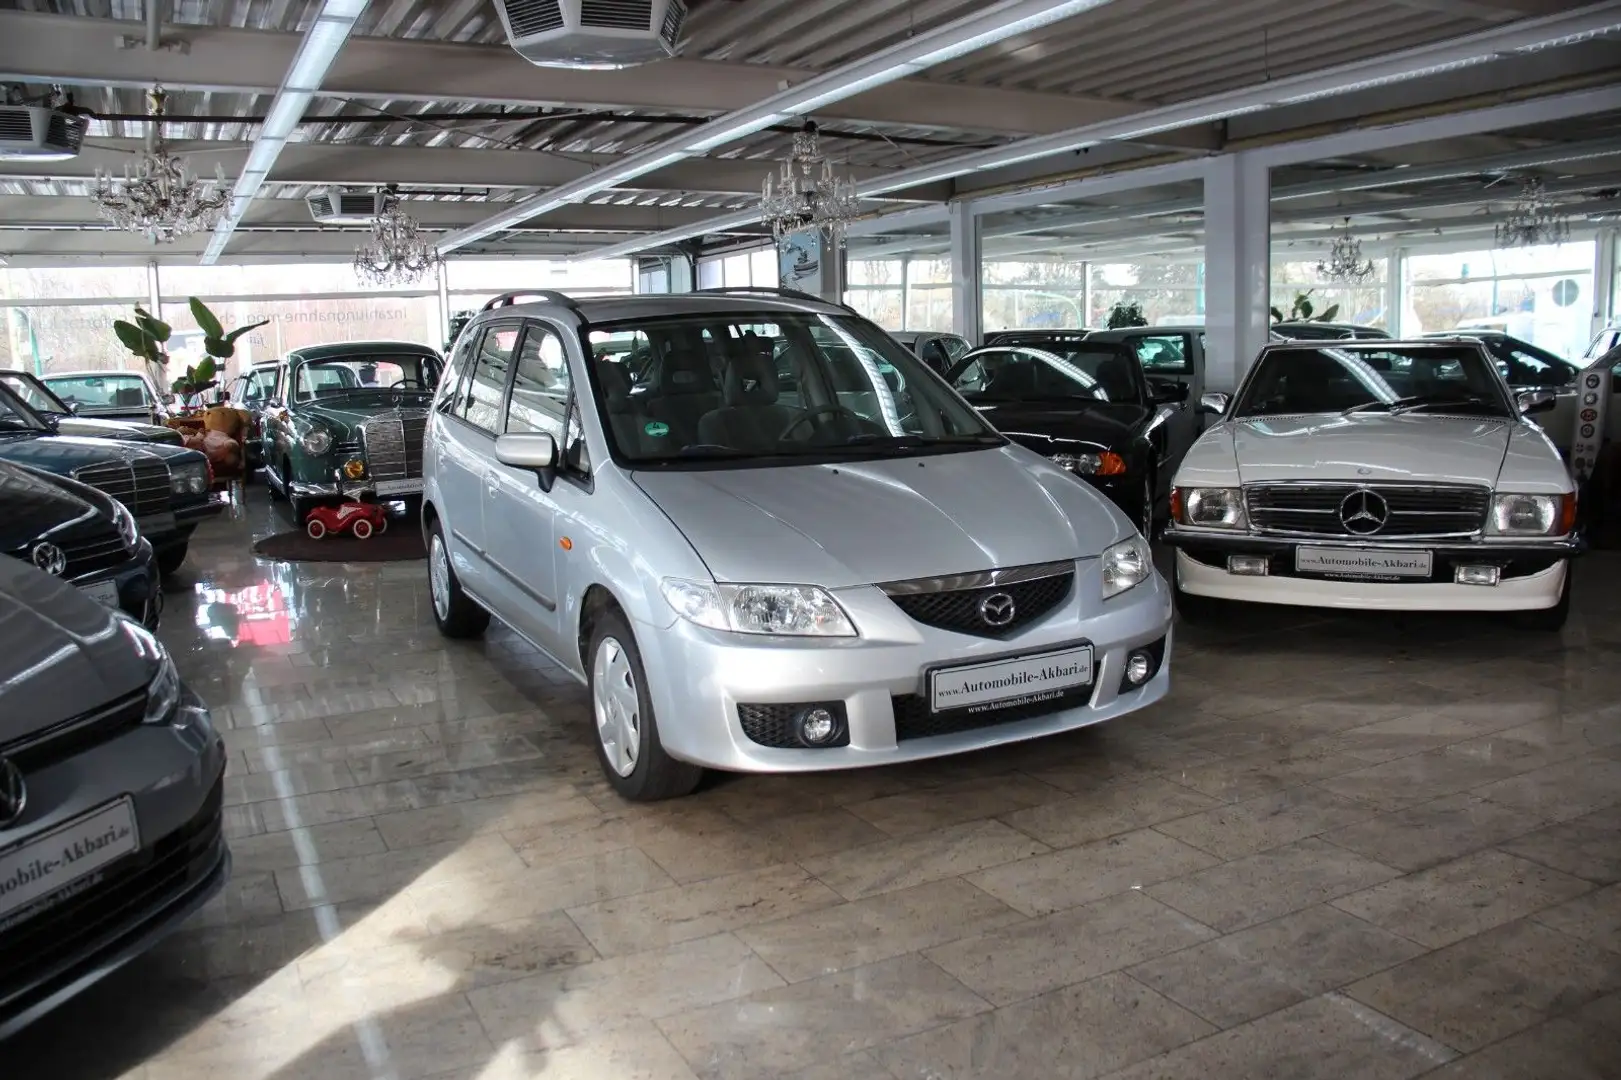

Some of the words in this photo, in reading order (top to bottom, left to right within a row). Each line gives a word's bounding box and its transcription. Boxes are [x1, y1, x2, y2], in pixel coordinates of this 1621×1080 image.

[1301, 556, 1427, 569] www.Automobile-Akbari.de
[938, 662, 1089, 698] www.Automobile-Akbari.de
[968, 690, 1065, 714] www.Automobile-Akbari.de
